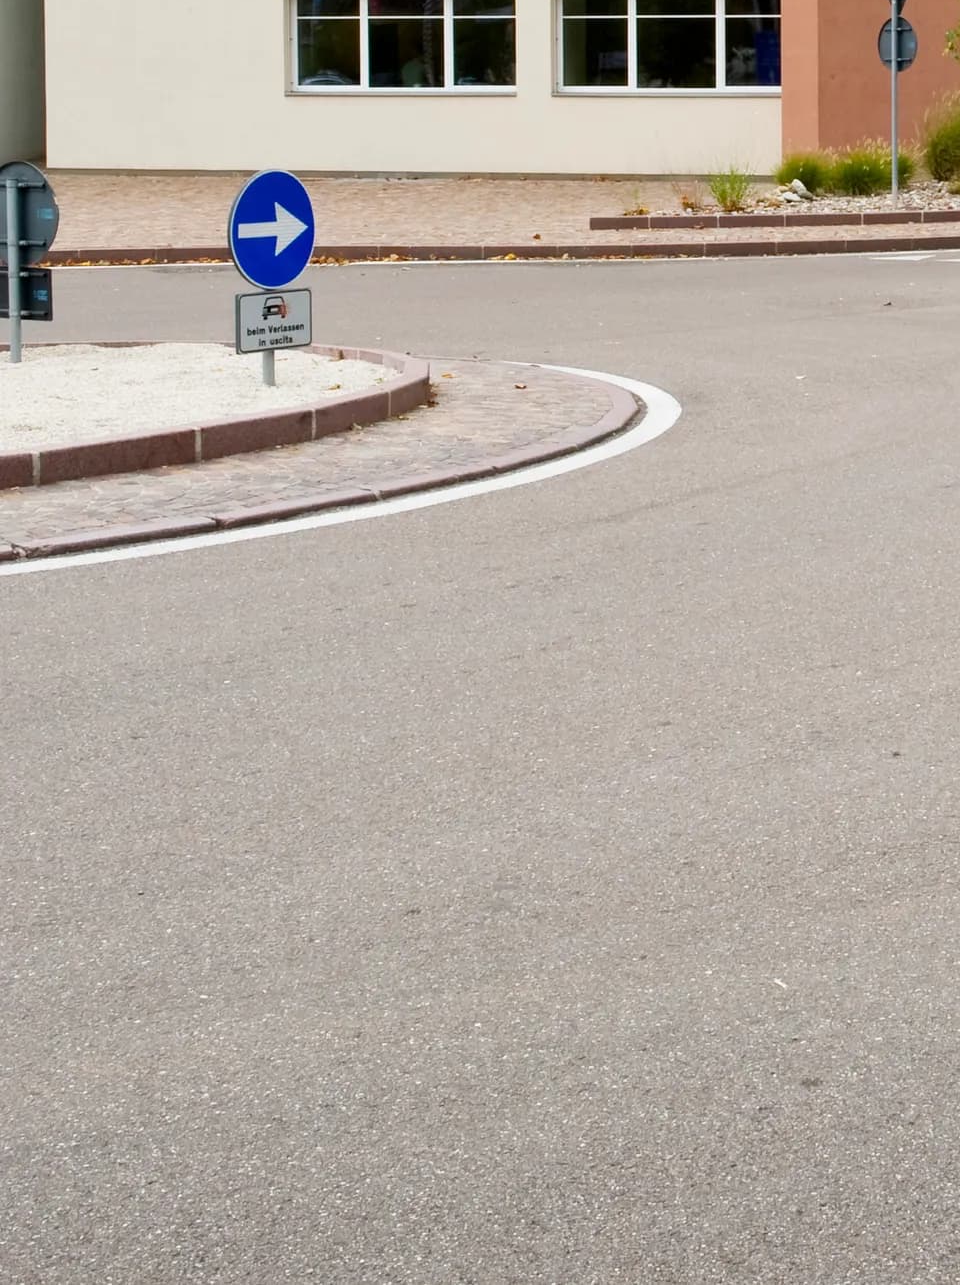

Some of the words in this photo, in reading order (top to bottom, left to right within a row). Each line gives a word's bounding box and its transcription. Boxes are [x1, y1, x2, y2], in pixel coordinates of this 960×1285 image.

[247, 327, 266, 336] beim
[268, 323, 304, 334] Verlassen
[258, 338, 266, 347] in
[270, 335, 293, 345] uscita
